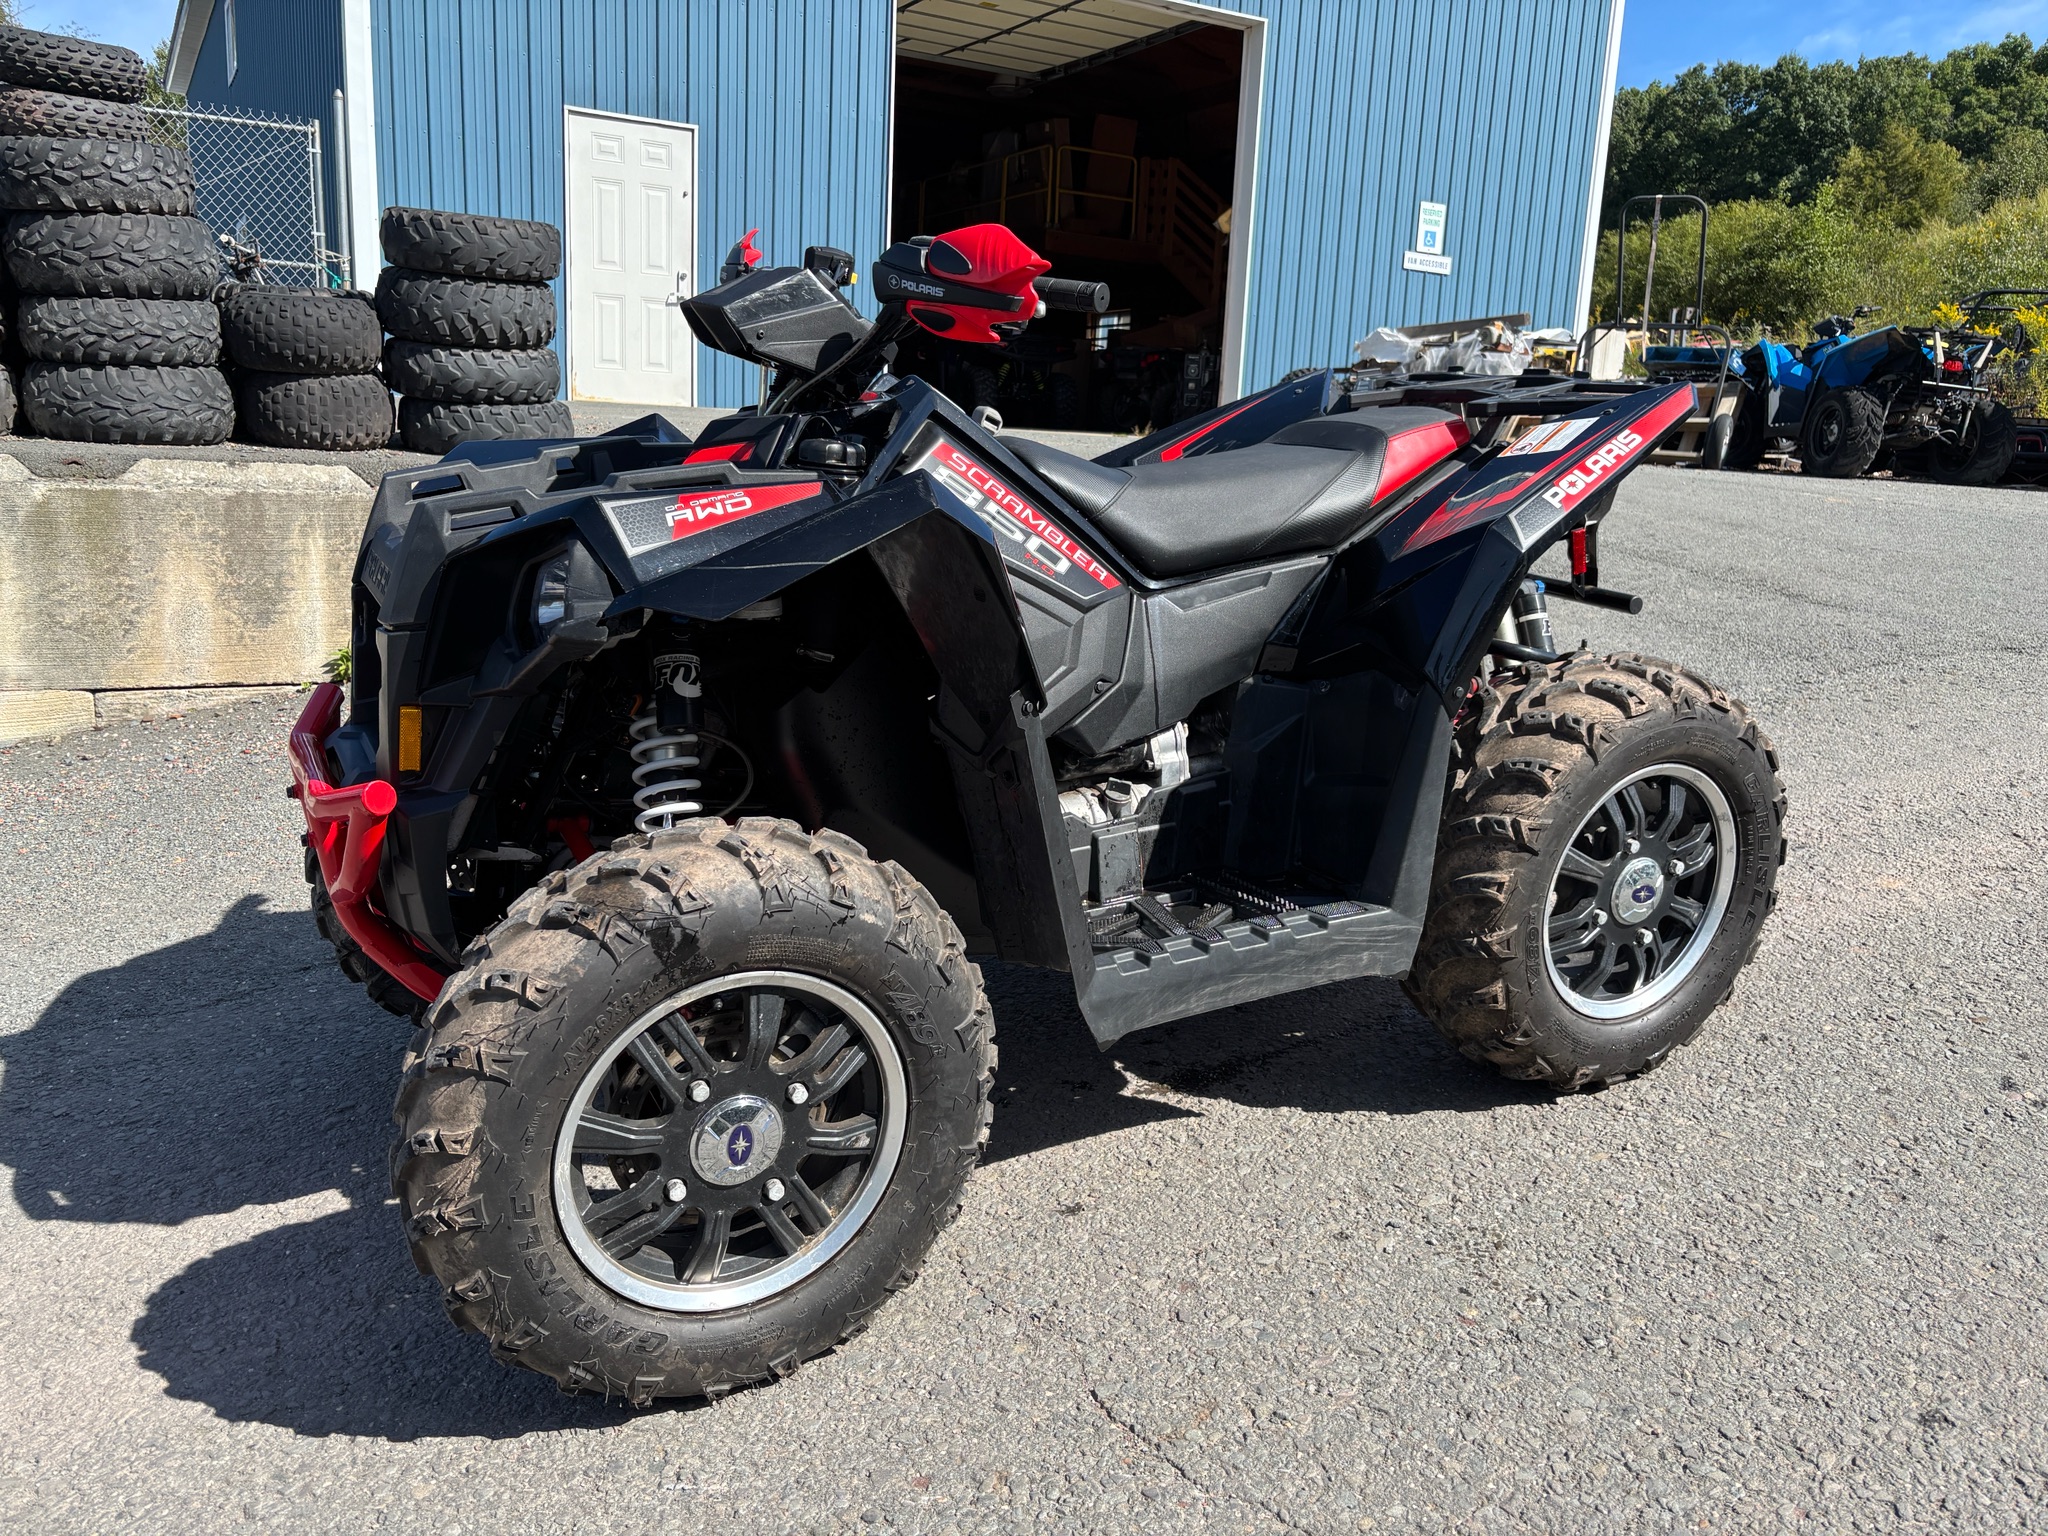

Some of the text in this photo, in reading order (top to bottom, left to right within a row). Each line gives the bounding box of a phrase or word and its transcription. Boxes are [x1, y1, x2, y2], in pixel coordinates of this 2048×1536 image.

[1423, 218, 1441, 227] PARKING
[901, 279, 945, 298] POLARIS
[1419, 258, 1448, 269] ACCESSIBLE
[1541, 428, 1643, 509] POLARIS
[664, 496, 753, 527] AWD
[932, 464, 1073, 576] 850
[948, 451, 1109, 581] SCRAMBLER
[654, 661, 701, 691] FOX
[1743, 771, 1771, 932] CARLISLE
[509, 1191, 669, 1356] CARLISLE
